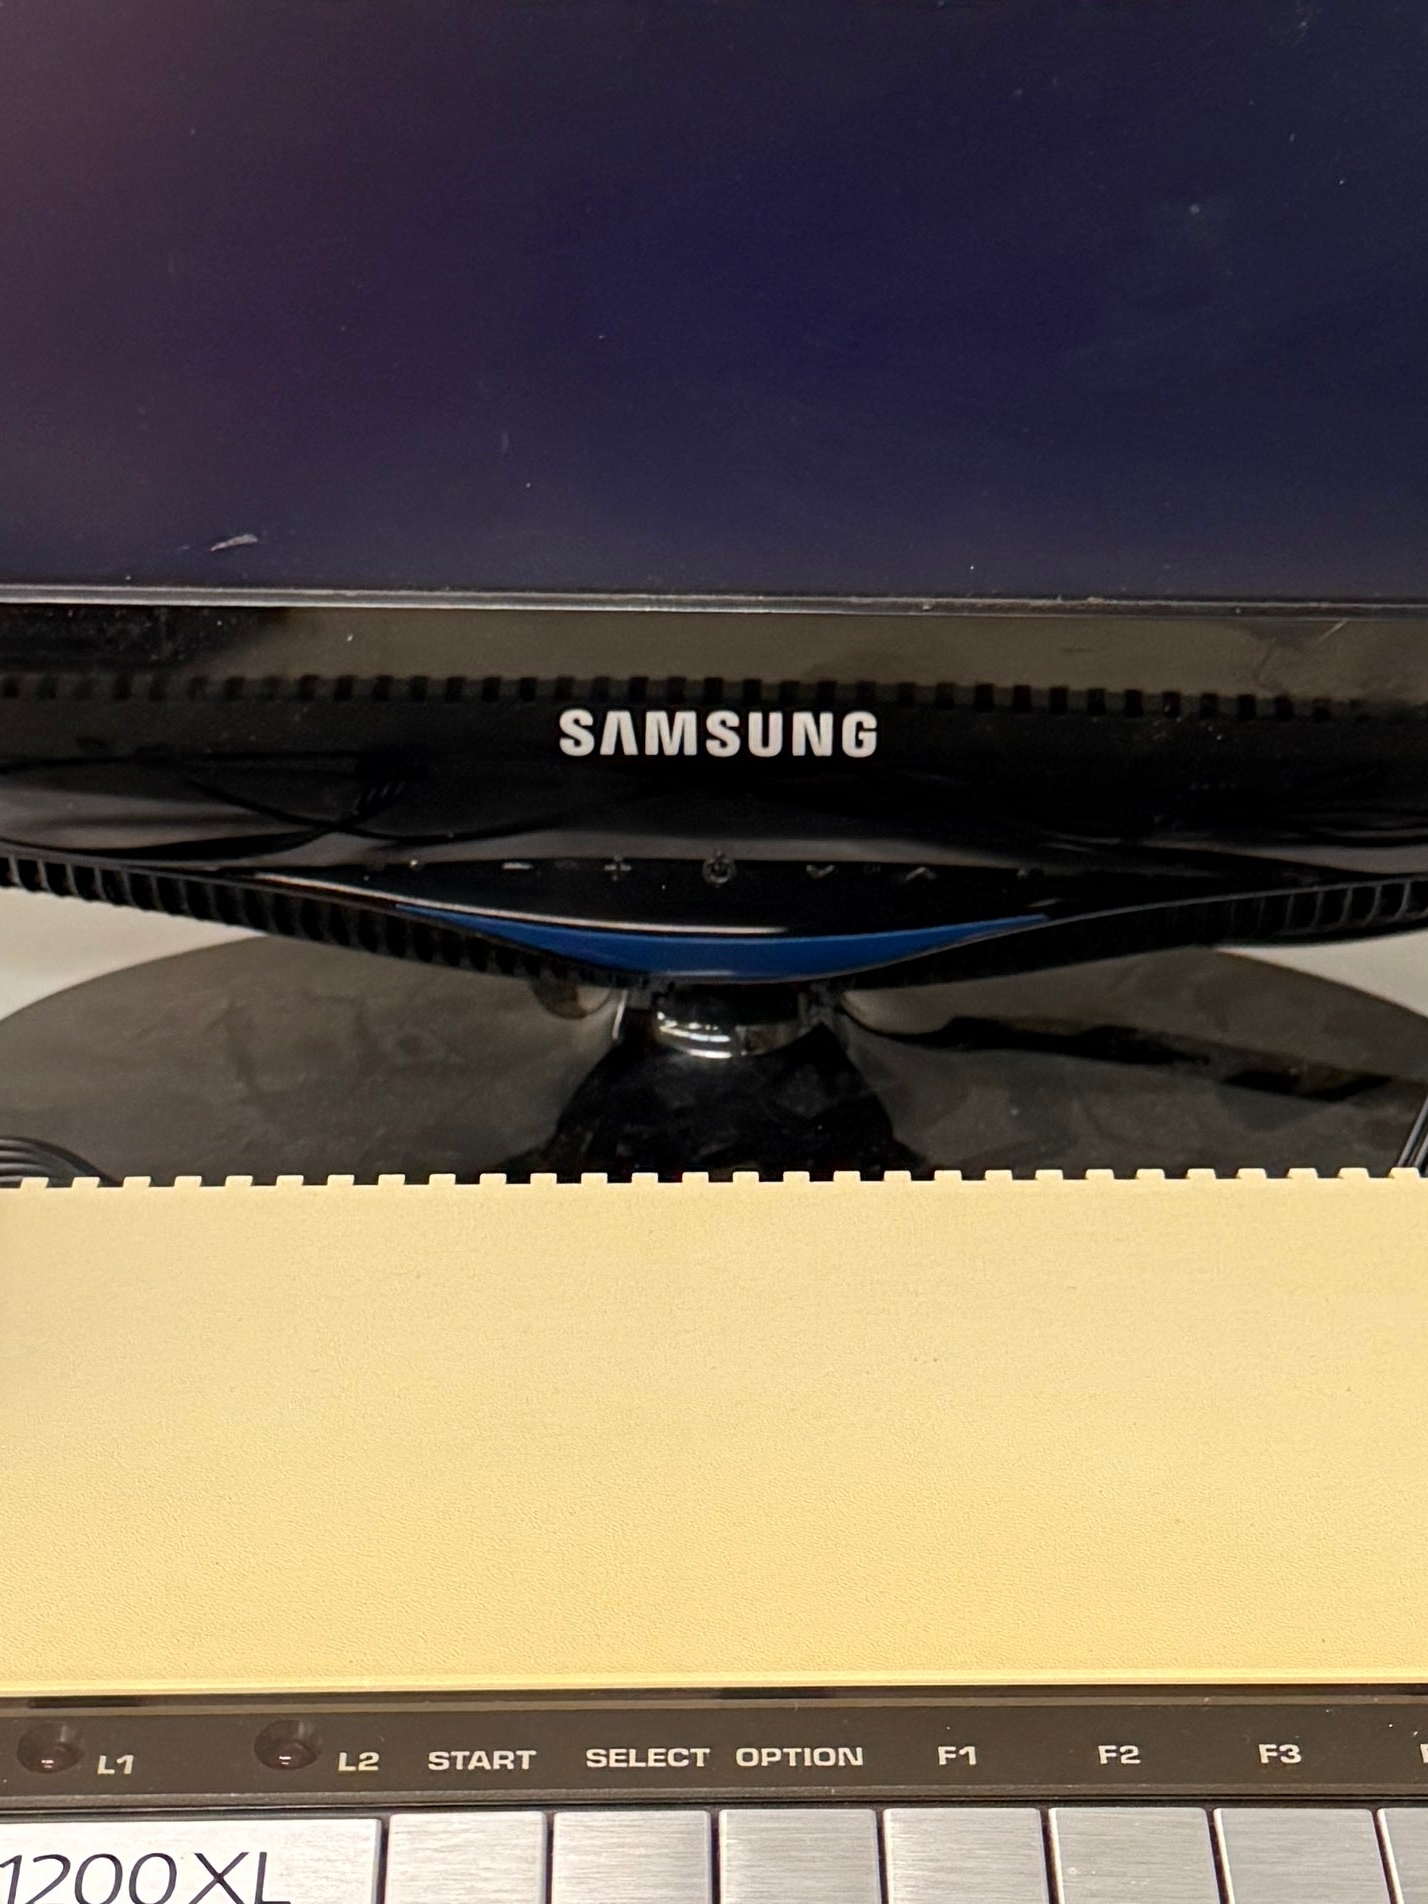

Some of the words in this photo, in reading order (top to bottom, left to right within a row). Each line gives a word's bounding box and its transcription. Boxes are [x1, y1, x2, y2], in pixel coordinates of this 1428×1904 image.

[558, 708, 878, 758] SAMSUNG
[97, 1754, 135, 1776] L1
[337, 1751, 380, 1773] L2
[427, 1748, 538, 1772] START
[585, 1746, 711, 1769] SELECT
[734, 1745, 865, 1769] OPTION
[937, 1745, 979, 1767] F1
[1098, 1744, 1142, 1767] F2
[1258, 1743, 1302, 1766] F3
